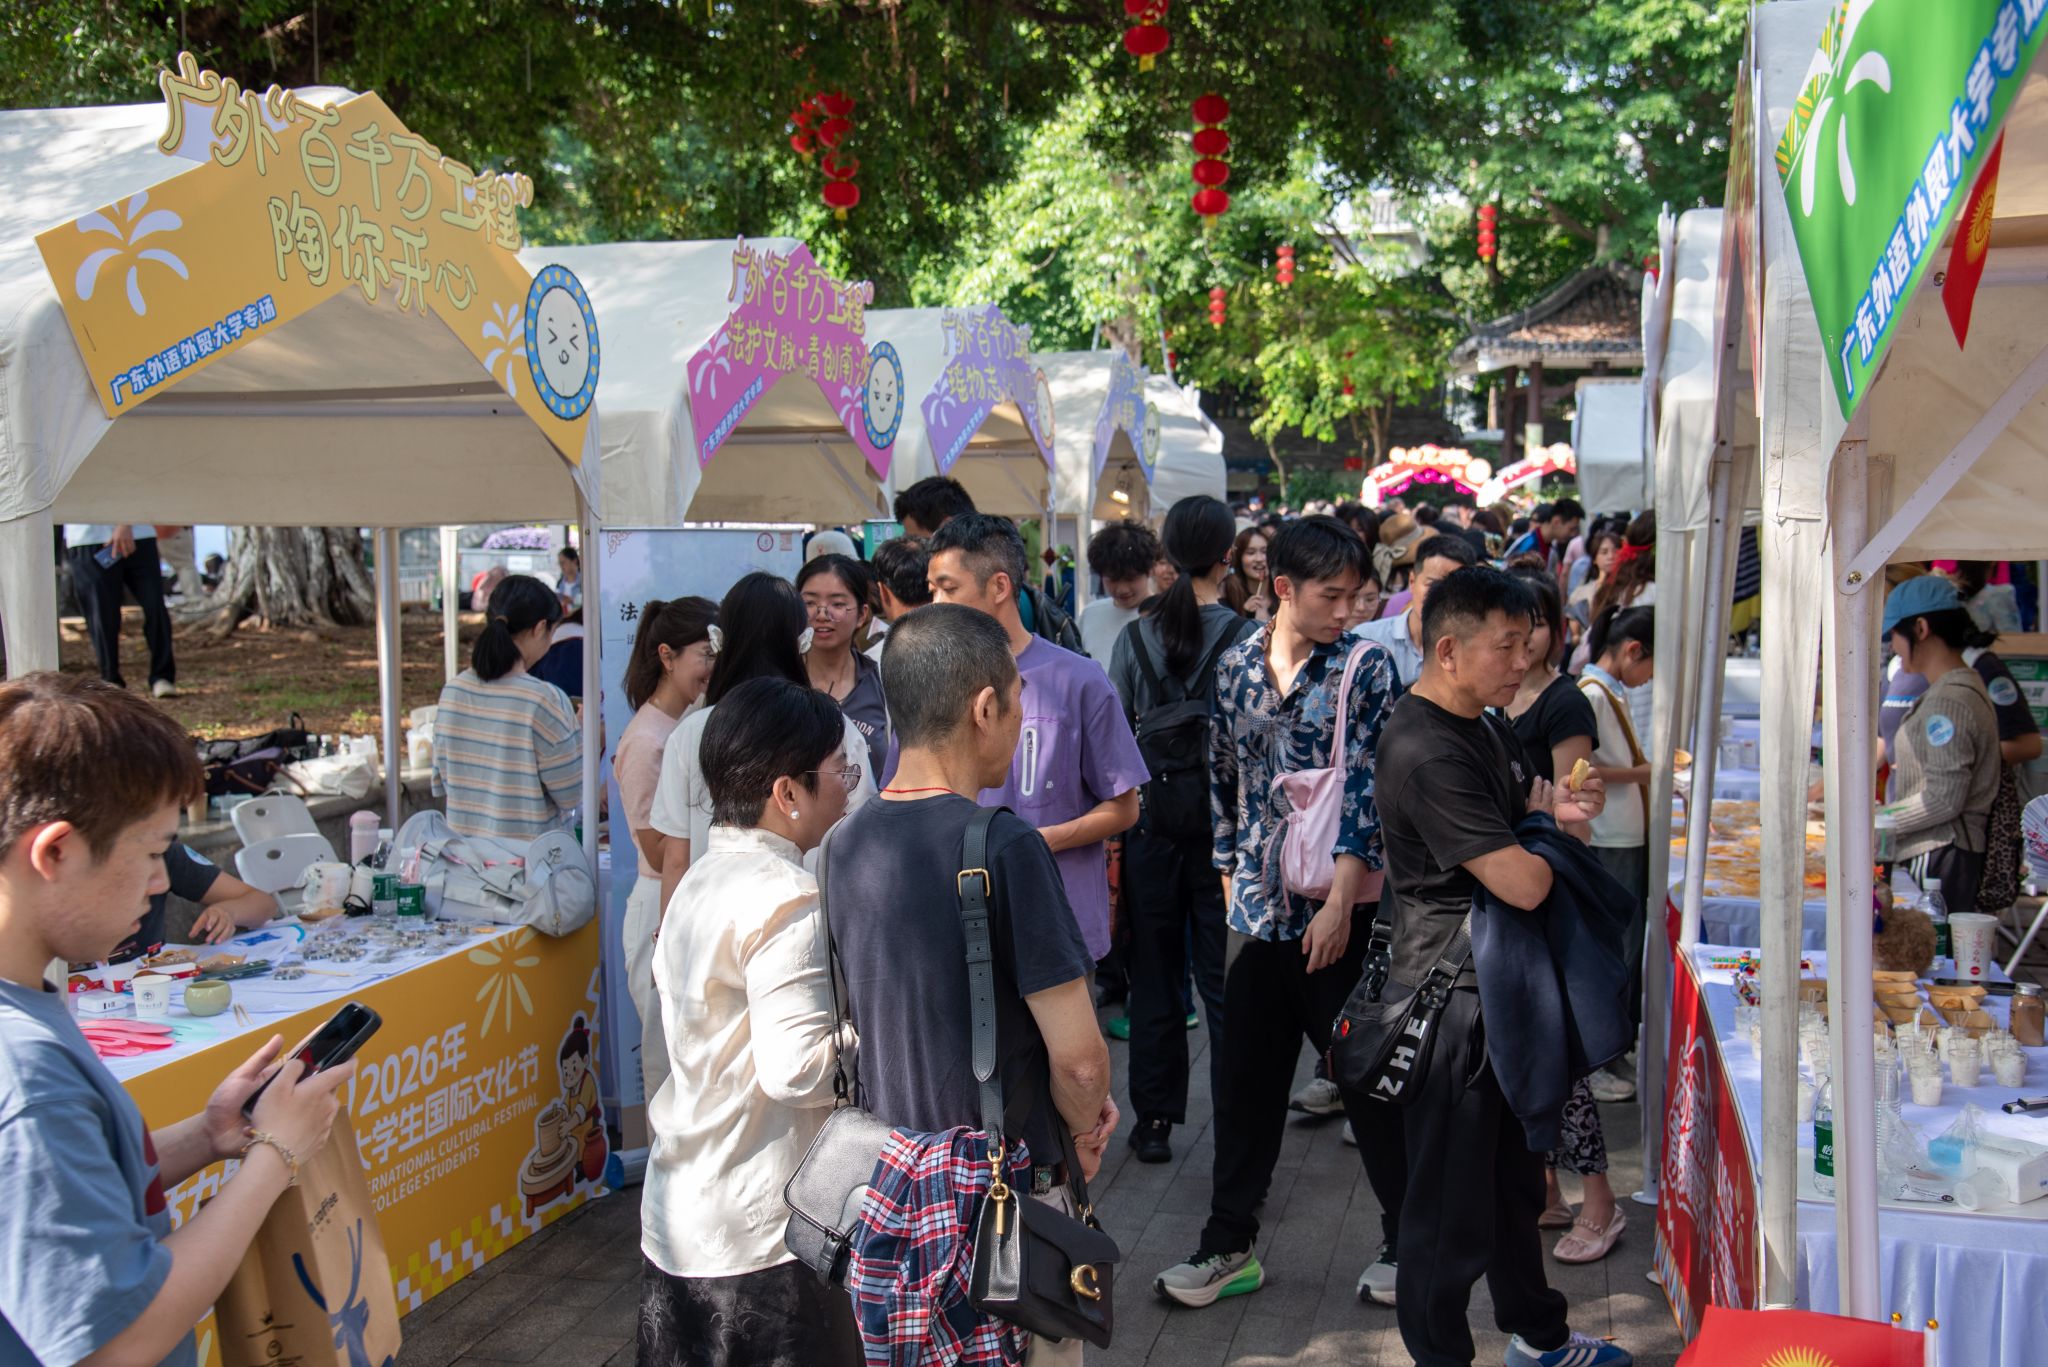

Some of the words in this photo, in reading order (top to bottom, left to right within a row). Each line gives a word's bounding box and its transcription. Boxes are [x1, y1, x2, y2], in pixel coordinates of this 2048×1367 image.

[267, 190, 478, 314] 陶你开心
[111, 295, 277, 405] 广东外语外贸大学专场
[852, 719, 875, 736] ION
[1368, 1016, 1428, 1101] ZHE
[368, 1147, 436, 1193] RNATIONAL
[439, 1118, 492, 1157] CULTURAL
[494, 1092, 539, 1127] FESTIVAL
[424, 1142, 480, 1185] STUDENTS
